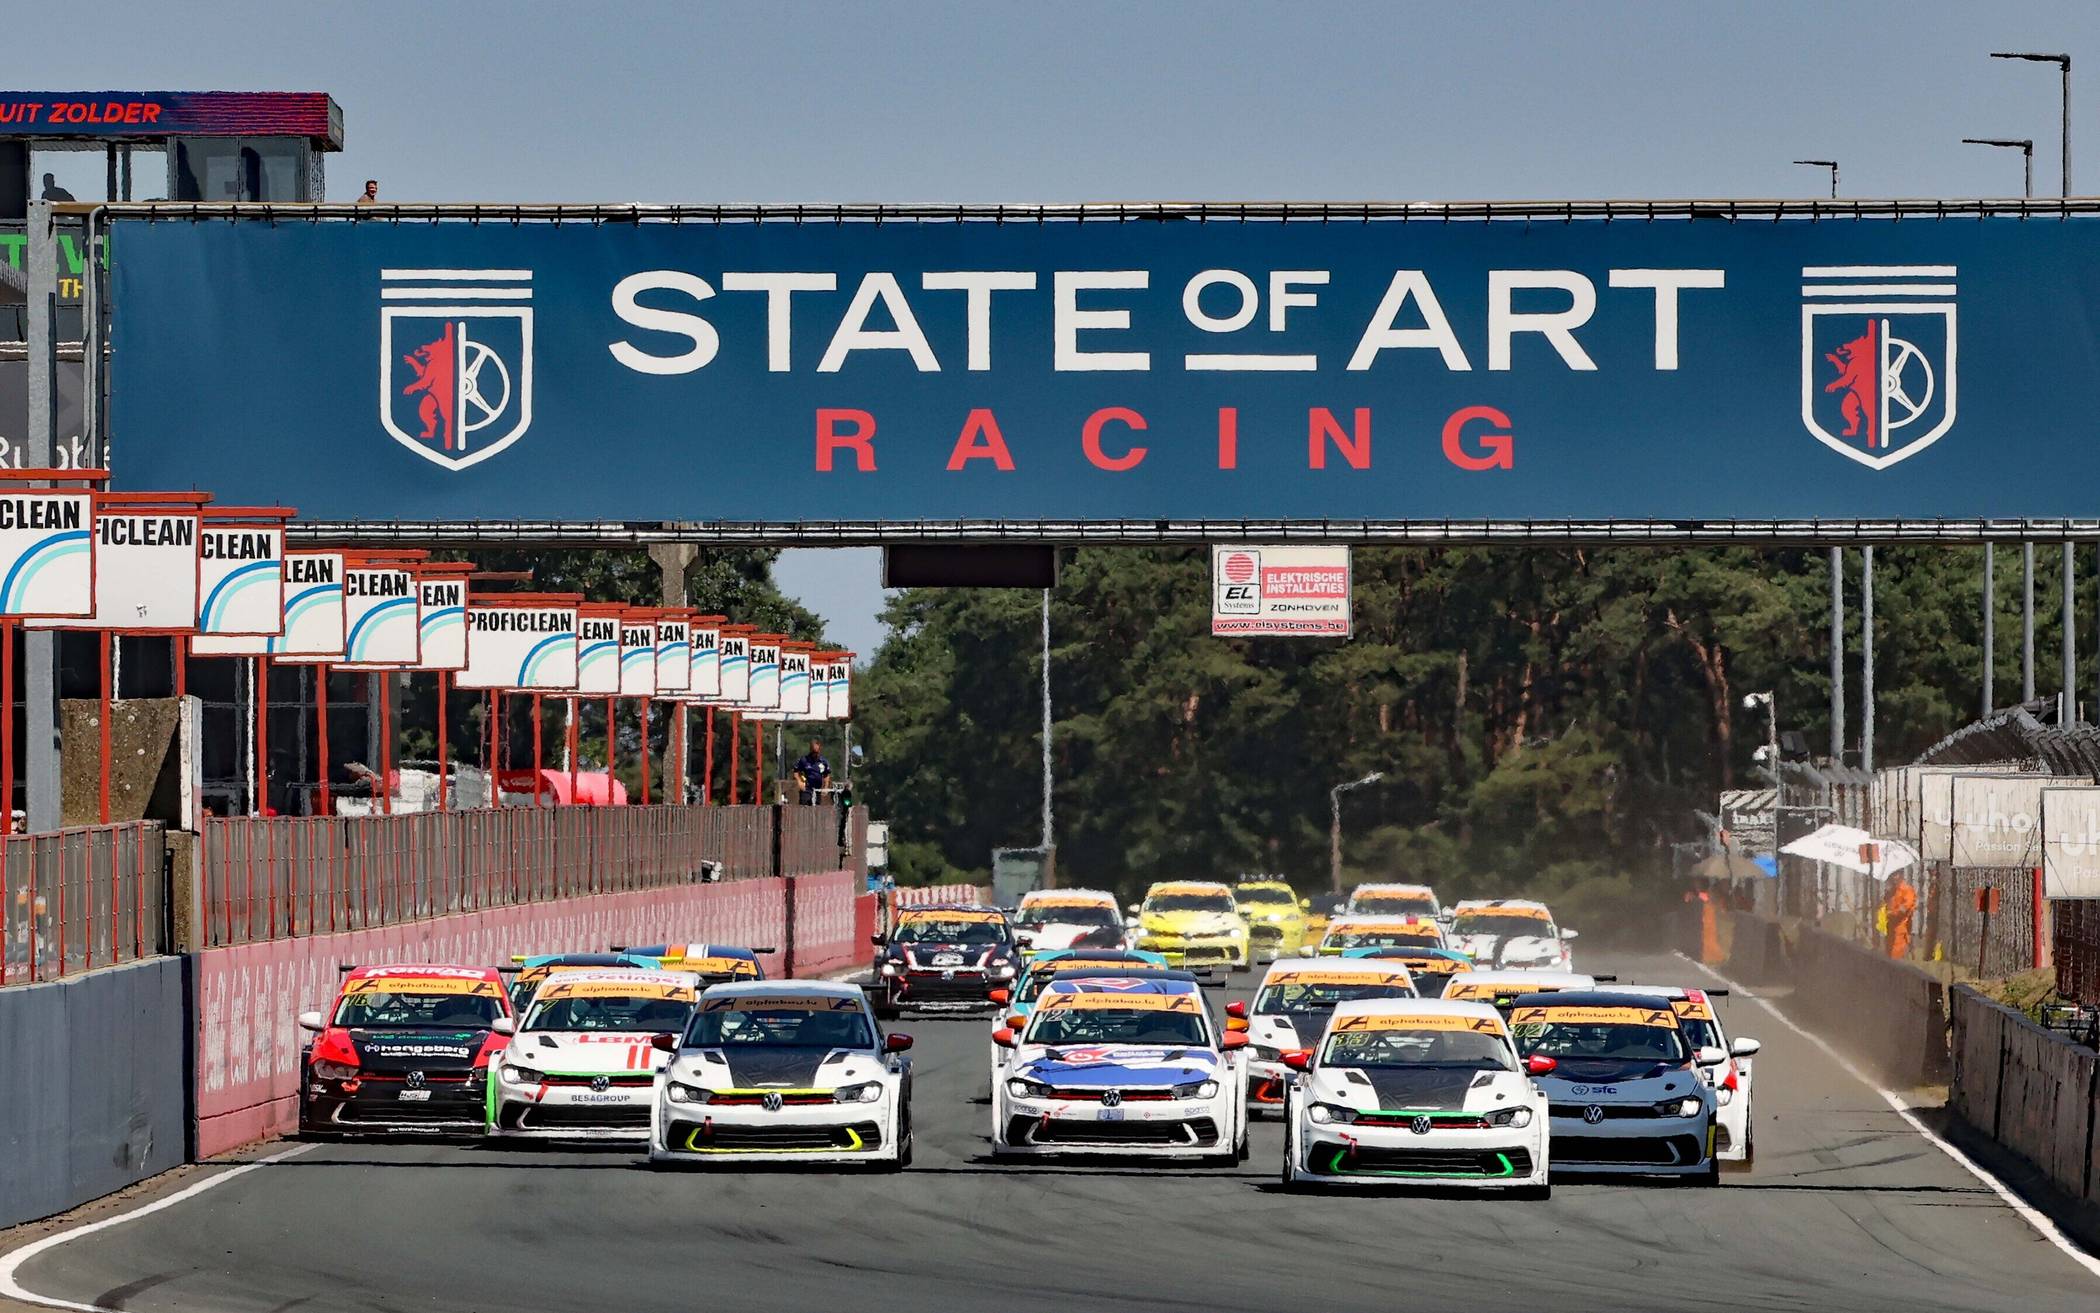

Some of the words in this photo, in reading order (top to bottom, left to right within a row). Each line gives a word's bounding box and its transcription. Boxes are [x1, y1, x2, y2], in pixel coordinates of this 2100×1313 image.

[48, 103, 161, 123] ZOLDER
[608, 270, 1151, 375] STATE
[1182, 268, 1330, 333] OF
[1346, 268, 1725, 371] ART
[815, 406, 1514, 472] RACING
[0, 499, 80, 530] CLEAN
[201, 533, 272, 560] CLEAN
[346, 573, 408, 597] CLEAN
[1266, 582, 1345, 593] INSTALLATIES
[1267, 572, 1344, 583] ELEKTRISCHE
[1225, 586, 1254, 600] EL
[1224, 601, 1255, 611] Systems
[1270, 604, 1339, 612] ZONHOVEN
[468, 611, 572, 632] PROFICLEAN
[579, 621, 614, 640] EAN
[1966, 792, 2041, 834] uho
[1591, 1085, 1617, 1095] sfc
